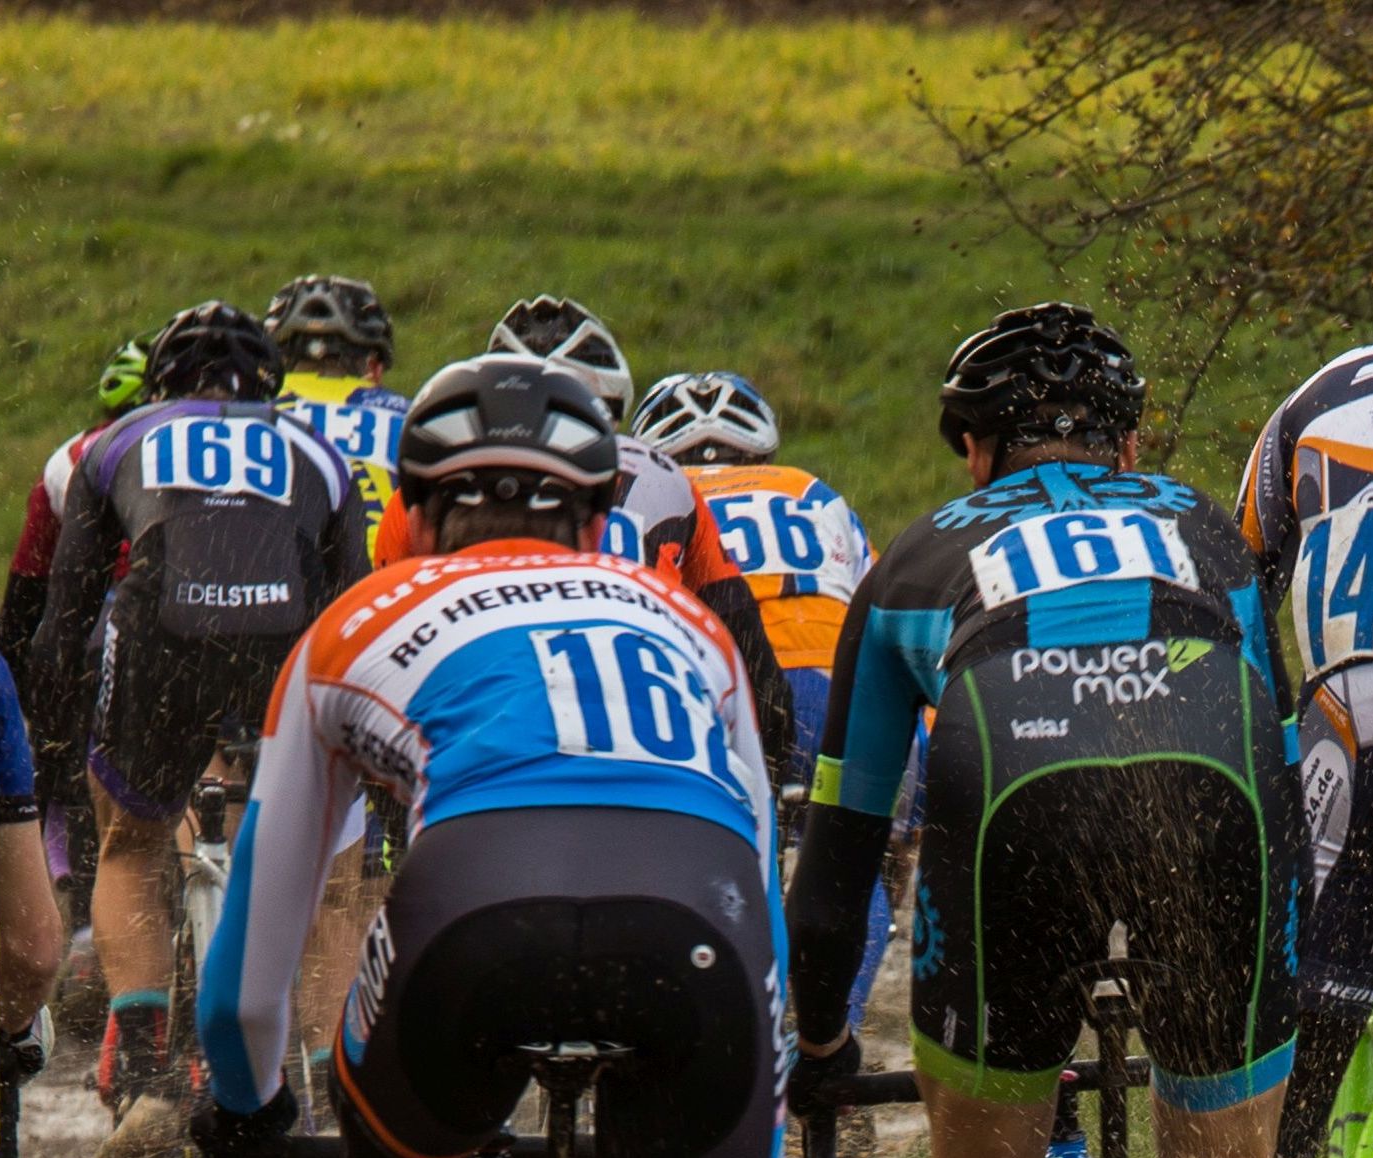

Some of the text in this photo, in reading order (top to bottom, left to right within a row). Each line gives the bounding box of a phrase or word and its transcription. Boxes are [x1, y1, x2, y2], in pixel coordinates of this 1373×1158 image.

[145, 420, 288, 498] 169
[985, 512, 1178, 595] 161
[388, 621, 439, 669] RC
[1011, 640, 1168, 682] power
[1072, 666, 1171, 705] max
[1010, 717, 1070, 740] kalas
